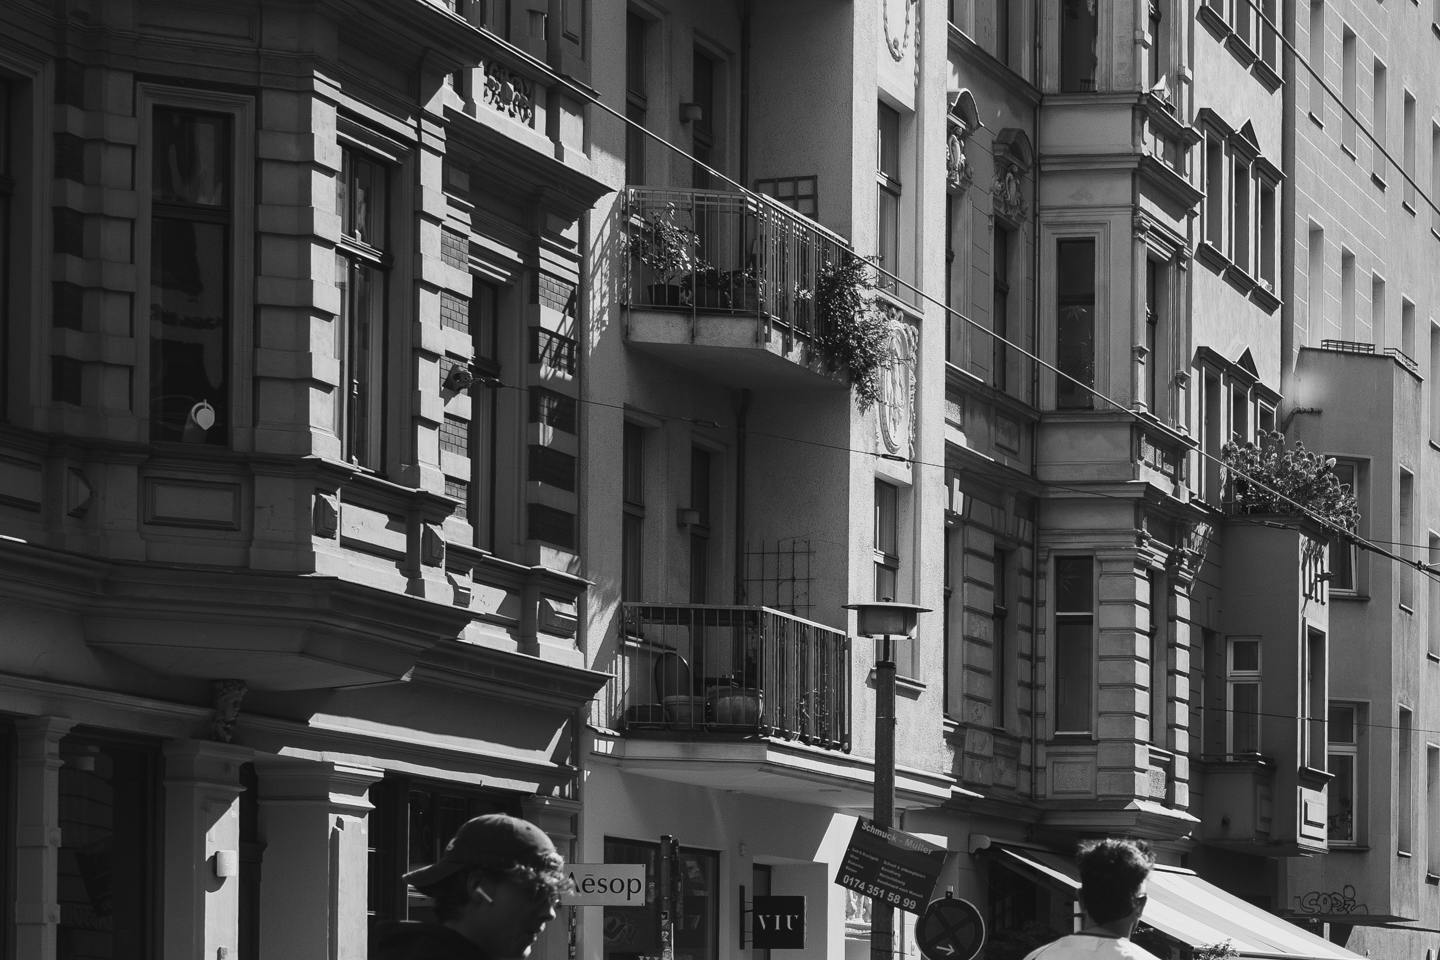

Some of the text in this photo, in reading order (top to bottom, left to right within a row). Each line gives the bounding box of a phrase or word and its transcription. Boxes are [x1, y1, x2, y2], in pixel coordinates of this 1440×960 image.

[861, 821, 898, 843] Schmuck
[843, 874, 918, 911] 0174 351 58 99
